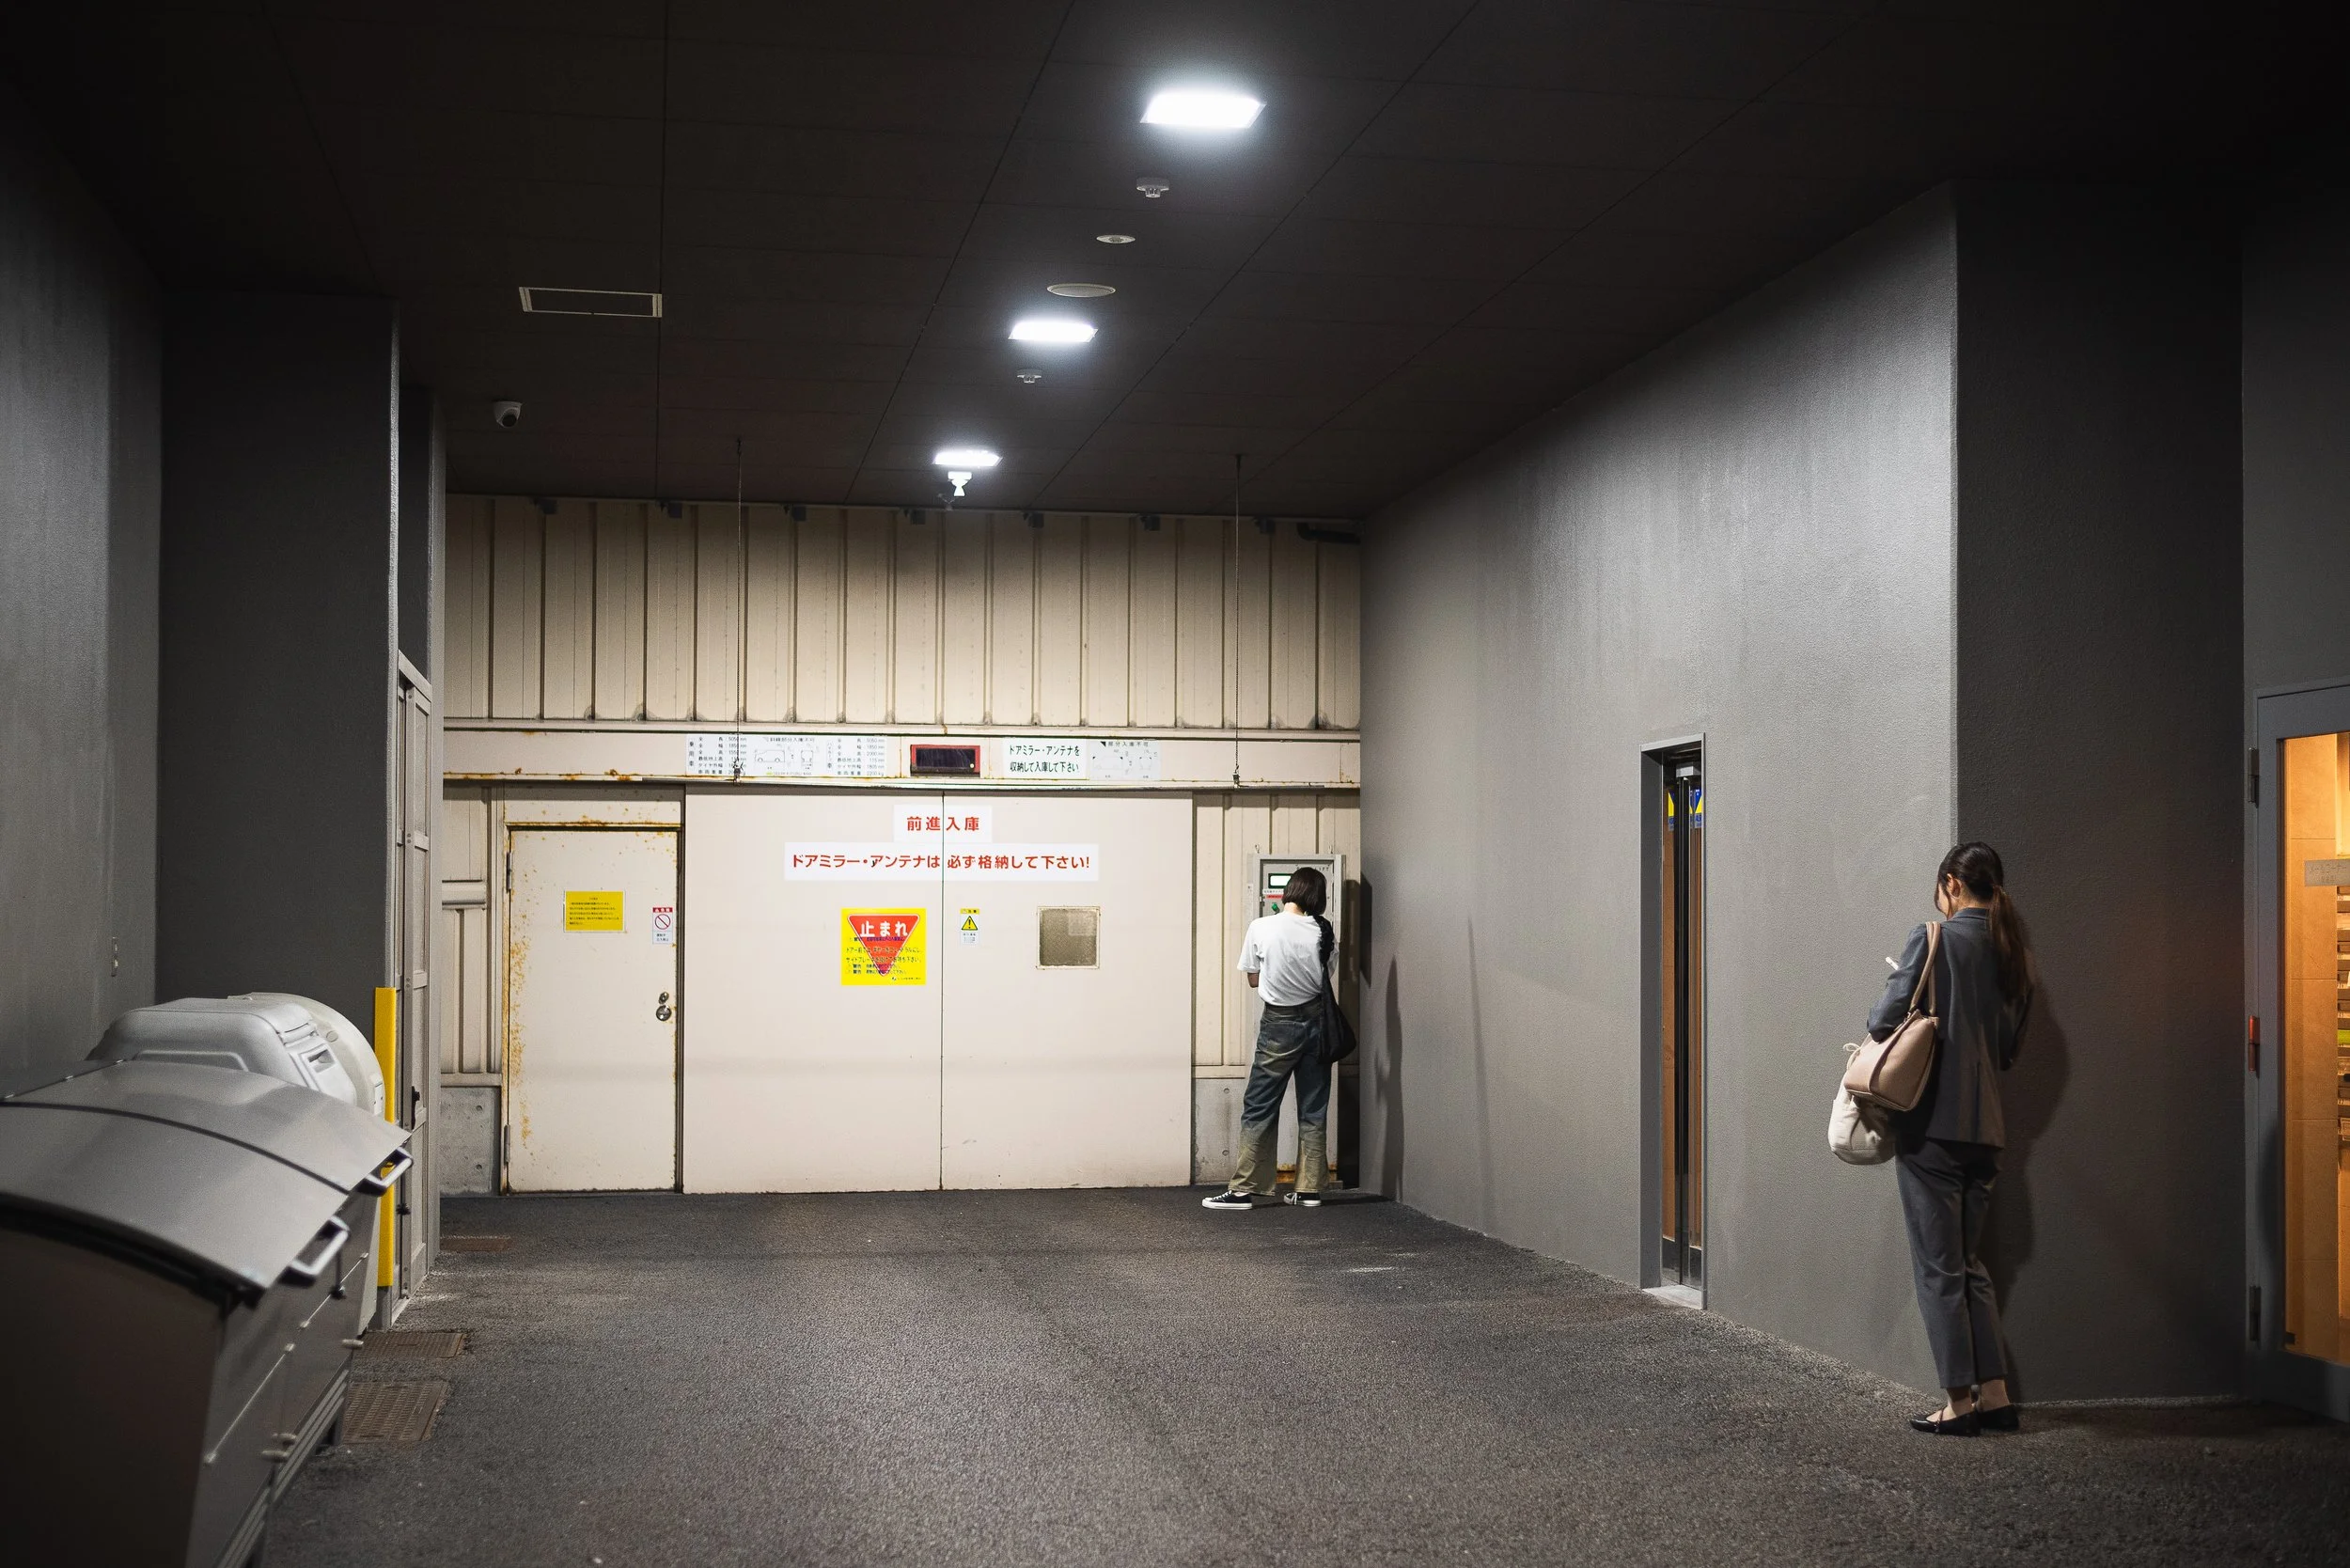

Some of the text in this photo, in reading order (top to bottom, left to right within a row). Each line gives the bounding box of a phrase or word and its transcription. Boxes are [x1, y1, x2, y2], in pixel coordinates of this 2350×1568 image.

[1010, 745, 1080, 756] ドアミラー・アンテナを
[1010, 761, 1079, 773] 収納して入庫して下さい
[907, 816, 979, 831] 前進入庫
[860, 921, 908, 937] 止まれ
